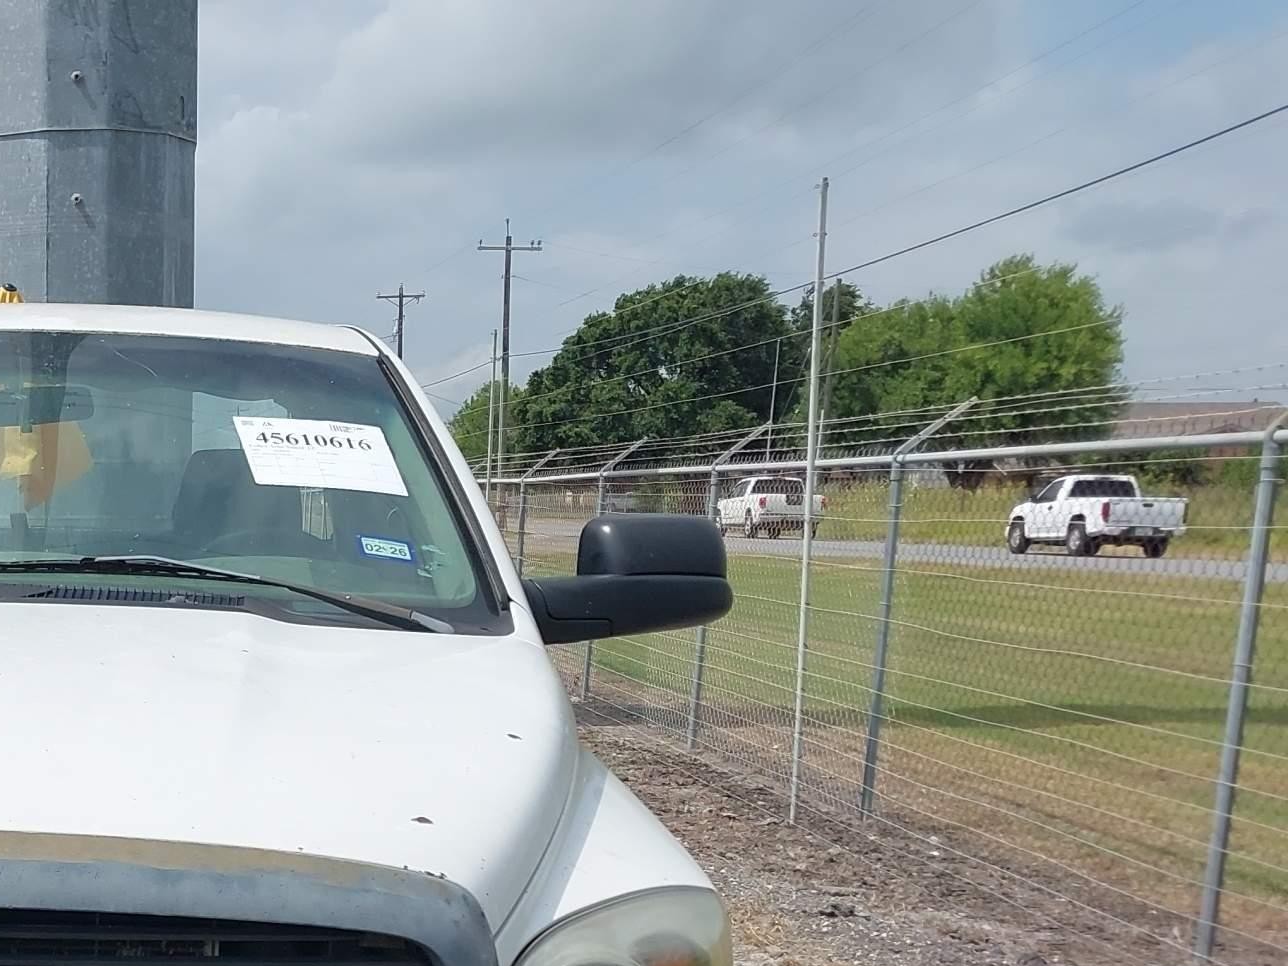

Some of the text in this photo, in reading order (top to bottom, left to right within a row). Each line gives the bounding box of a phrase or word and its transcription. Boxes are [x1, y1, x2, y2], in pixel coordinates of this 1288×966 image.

[255, 431, 373, 452] 45610616
[365, 543, 384, 553] 02
[389, 546, 408, 557] 26
